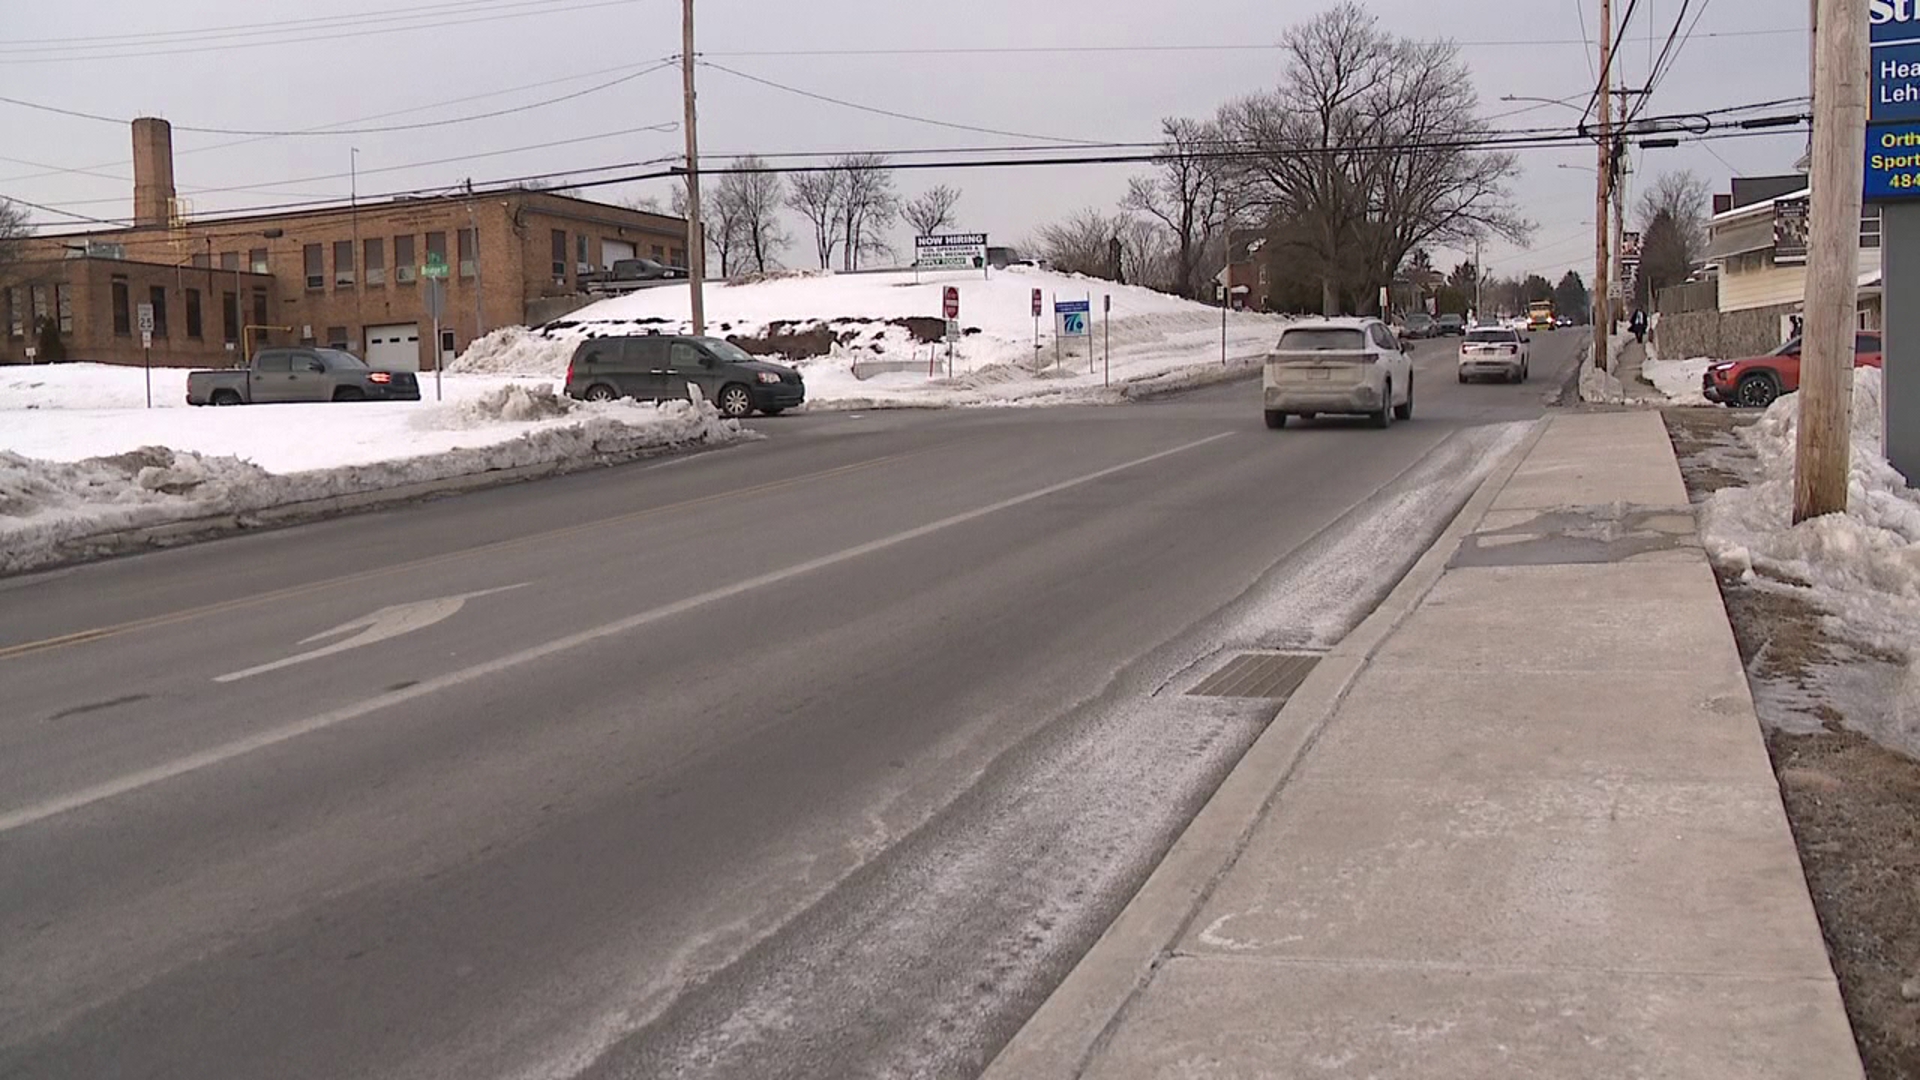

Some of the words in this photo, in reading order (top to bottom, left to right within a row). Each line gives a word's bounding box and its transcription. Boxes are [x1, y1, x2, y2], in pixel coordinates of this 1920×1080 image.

[1881, 60, 1920, 79] Hea
[1871, 153, 1920, 171] Sport
[918, 236, 943, 246] NOW
[945, 235, 983, 245] HIRING
[140, 317, 152, 328] 25
